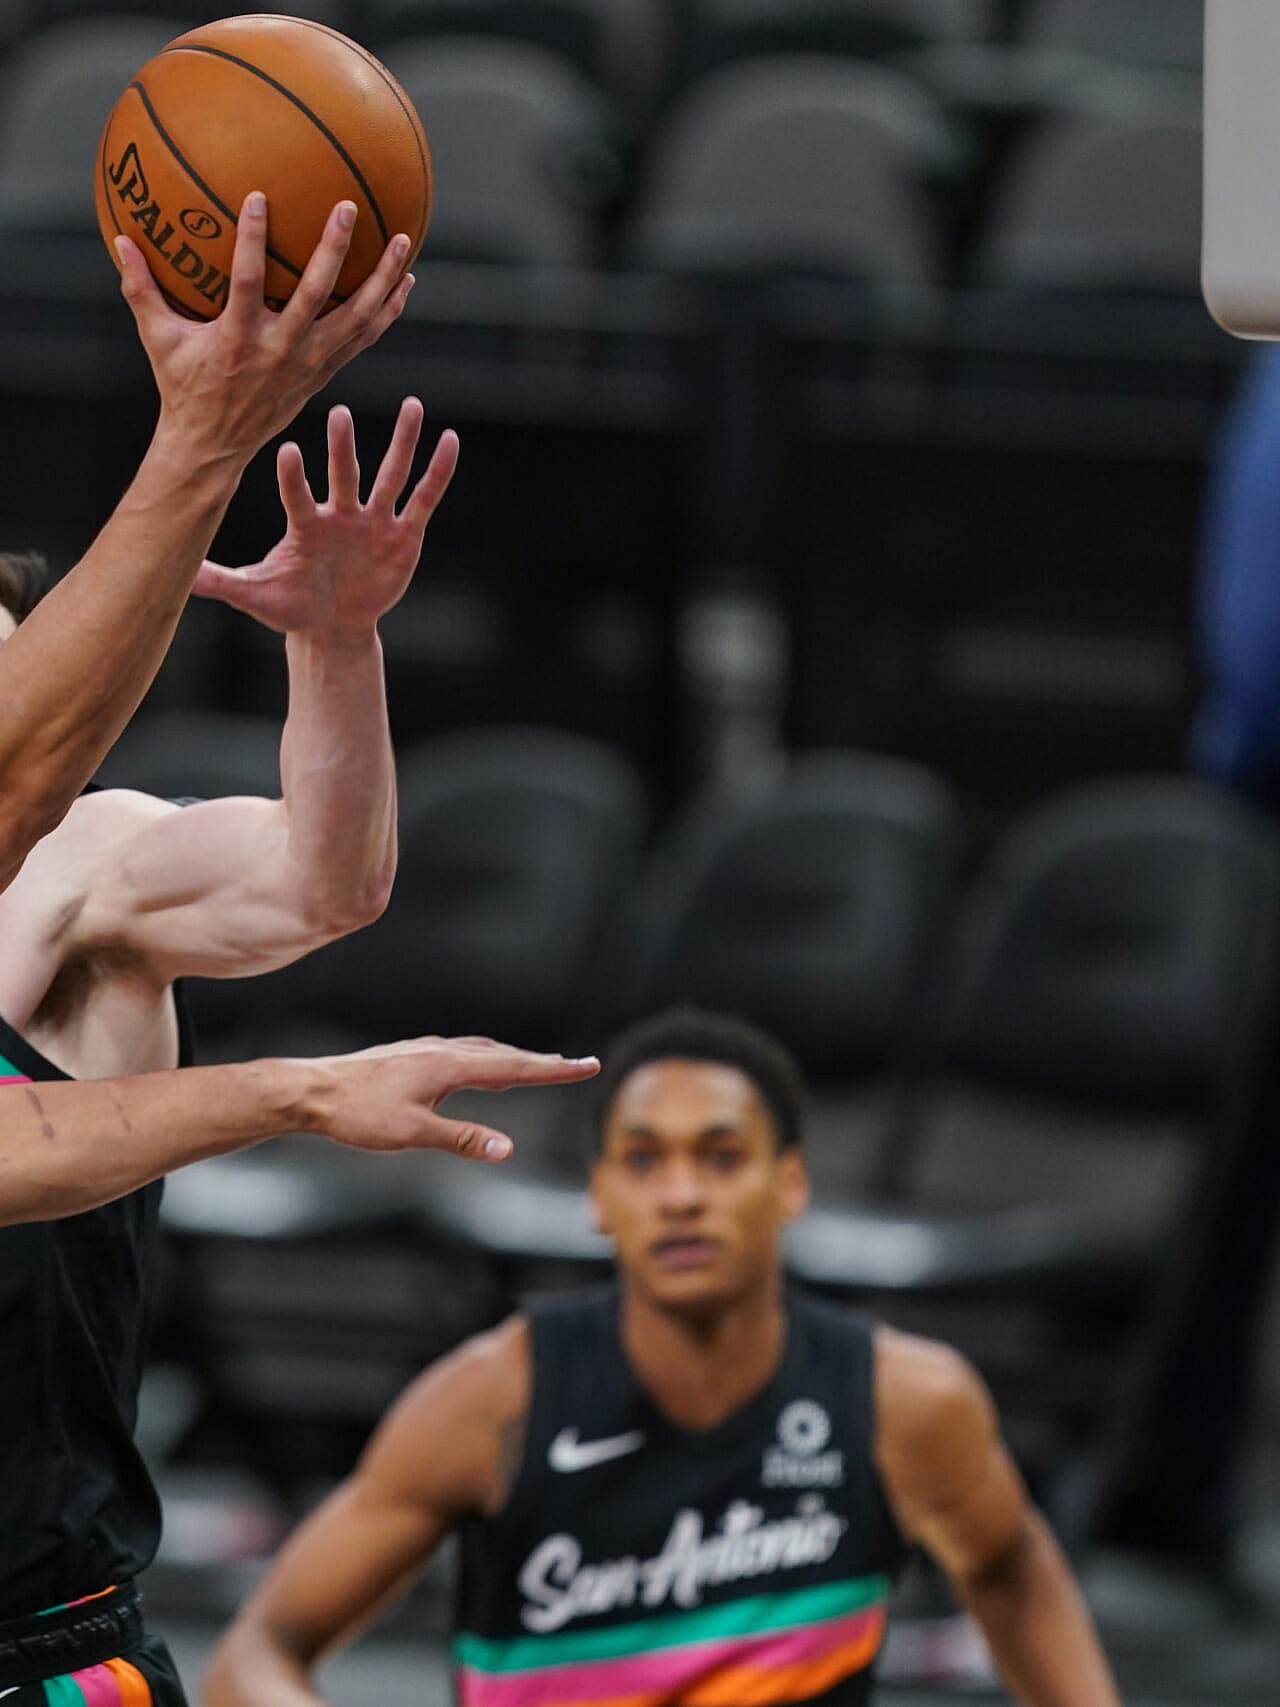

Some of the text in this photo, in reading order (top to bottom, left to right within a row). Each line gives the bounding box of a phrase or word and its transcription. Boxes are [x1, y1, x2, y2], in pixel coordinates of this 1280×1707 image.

[109, 142, 230, 303] SPALDIN
[518, 1496, 847, 1633] San Antonio
